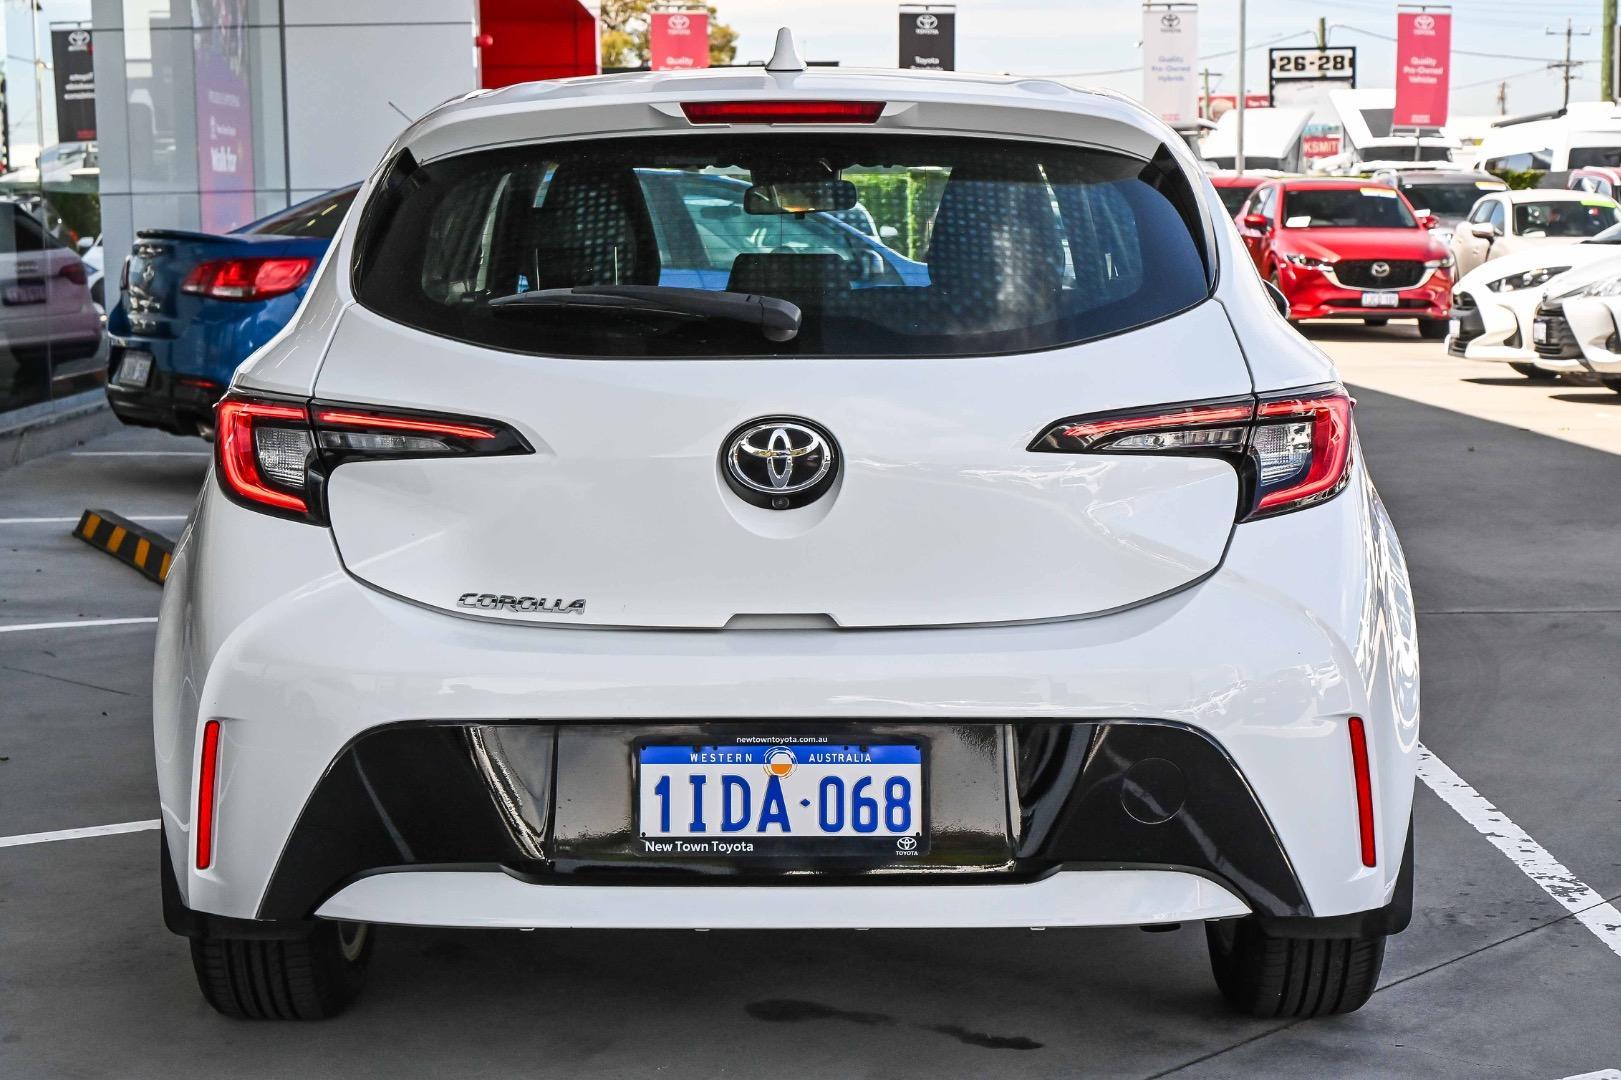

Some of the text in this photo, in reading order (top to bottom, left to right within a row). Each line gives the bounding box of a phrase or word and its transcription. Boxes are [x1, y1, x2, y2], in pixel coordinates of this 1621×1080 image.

[1279, 55, 1346, 72] 26-28
[1410, 56, 1438, 67] Quality
[456, 592, 587, 616] COROLLA
[736, 735, 828, 744] newtowntoyota.com.au
[690, 753, 872, 763] WESTERN AUSTRALIA
[645, 841, 754, 855] New Town Toyota
